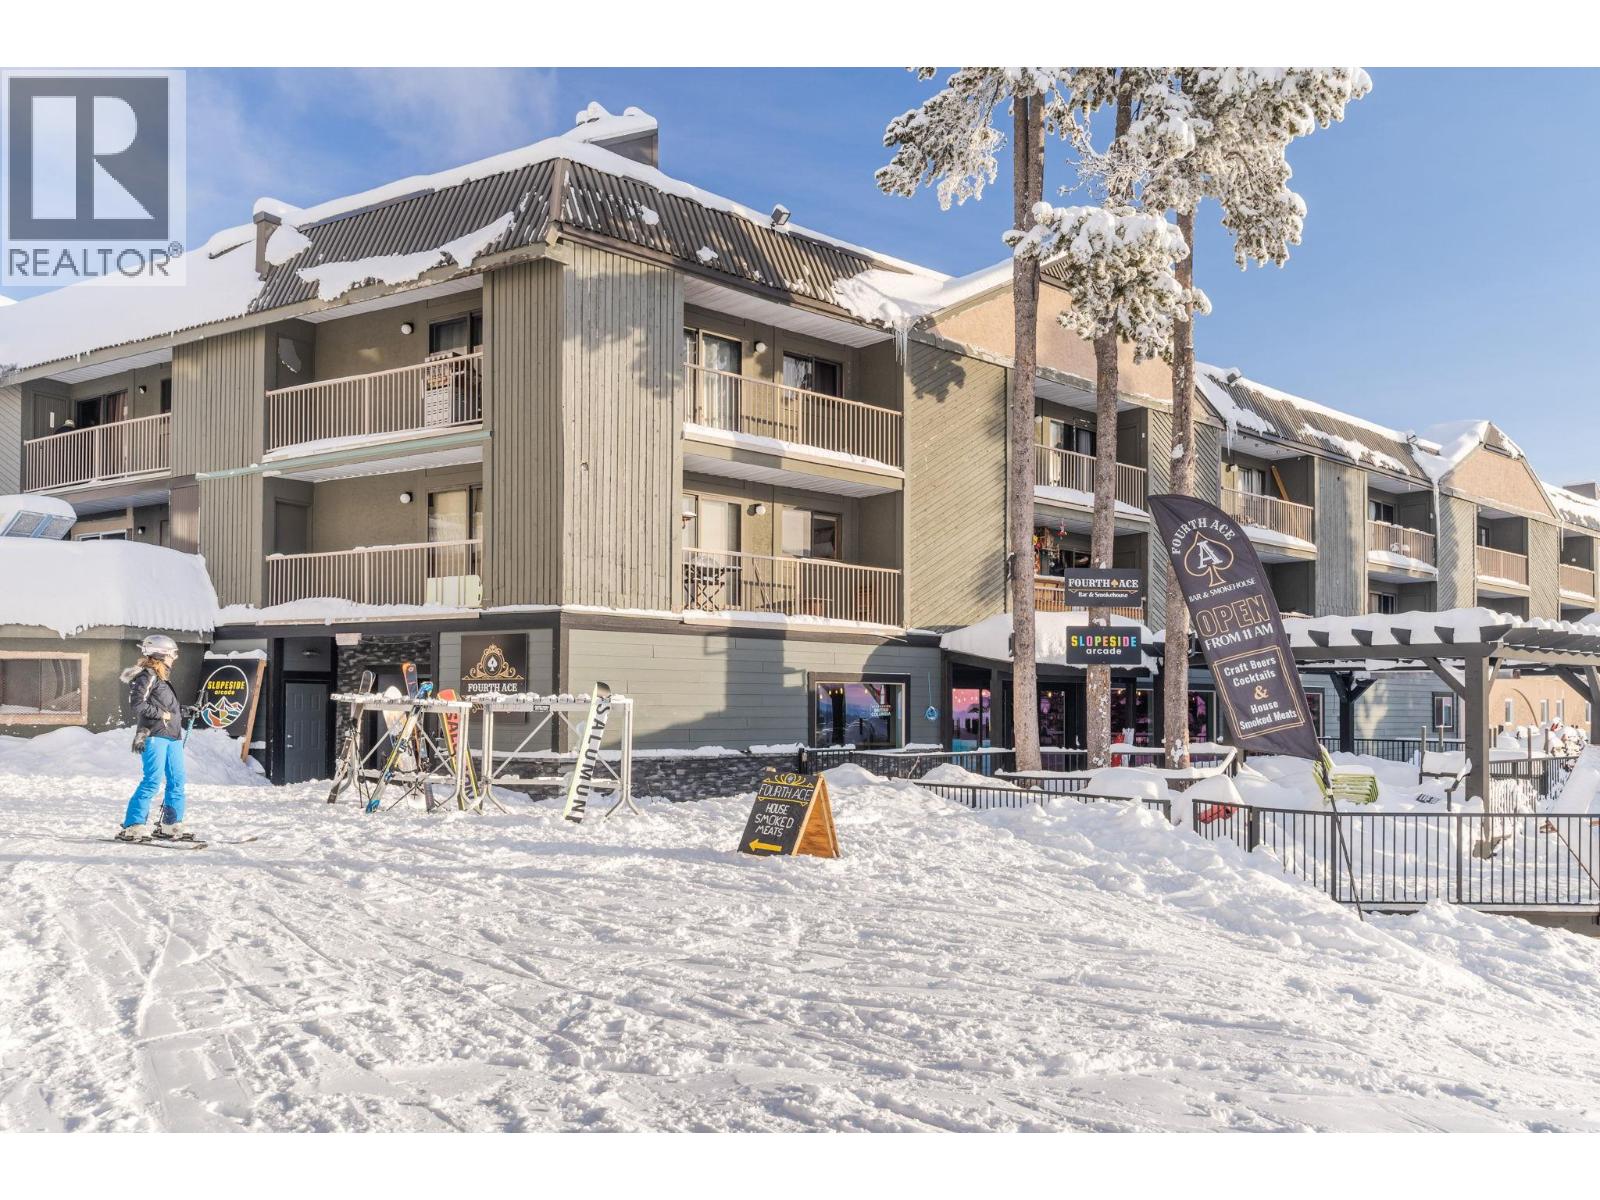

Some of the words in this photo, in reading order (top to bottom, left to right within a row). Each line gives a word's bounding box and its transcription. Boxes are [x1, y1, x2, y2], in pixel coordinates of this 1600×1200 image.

[1171, 517, 1208, 555] FOURTH
[1210, 519, 1236, 541] ACE
[1068, 578, 1111, 588] FOURTH
[1118, 579, 1139, 588] ACE
[1188, 593, 1202, 603] BAR
[1202, 591, 1209, 599] &
[1210, 577, 1257, 597] SMOKEHOUSE
[1195, 594, 1271, 638] OPEN
[1071, 635, 1137, 647] SLOPESIDE
[1204, 631, 1241, 651] FROM
[1242, 628, 1253, 640] 11
[1254, 622, 1274, 638] AM
[1086, 647, 1122, 655] arcade
[1223, 662, 1249, 676] Craft
[1249, 657, 1277, 670] Beers
[207, 680, 246, 690] SLOPESIDE
[1232, 669, 1277, 687] Cocktails
[467, 683, 500, 692] FOURTH
[501, 683, 518, 692] ACE
[1254, 685, 1269, 700] &
[1250, 700, 1279, 714] House
[1239, 713, 1273, 730] Smoked
[1273, 709, 1298, 721] Meats
[758, 783, 792, 799] FOURTH
[792, 787, 814, 801] ACE
[765, 803, 791, 815] HOUSE
[754, 813, 795, 829] SMOKED
[755, 825, 784, 837] MEATS
